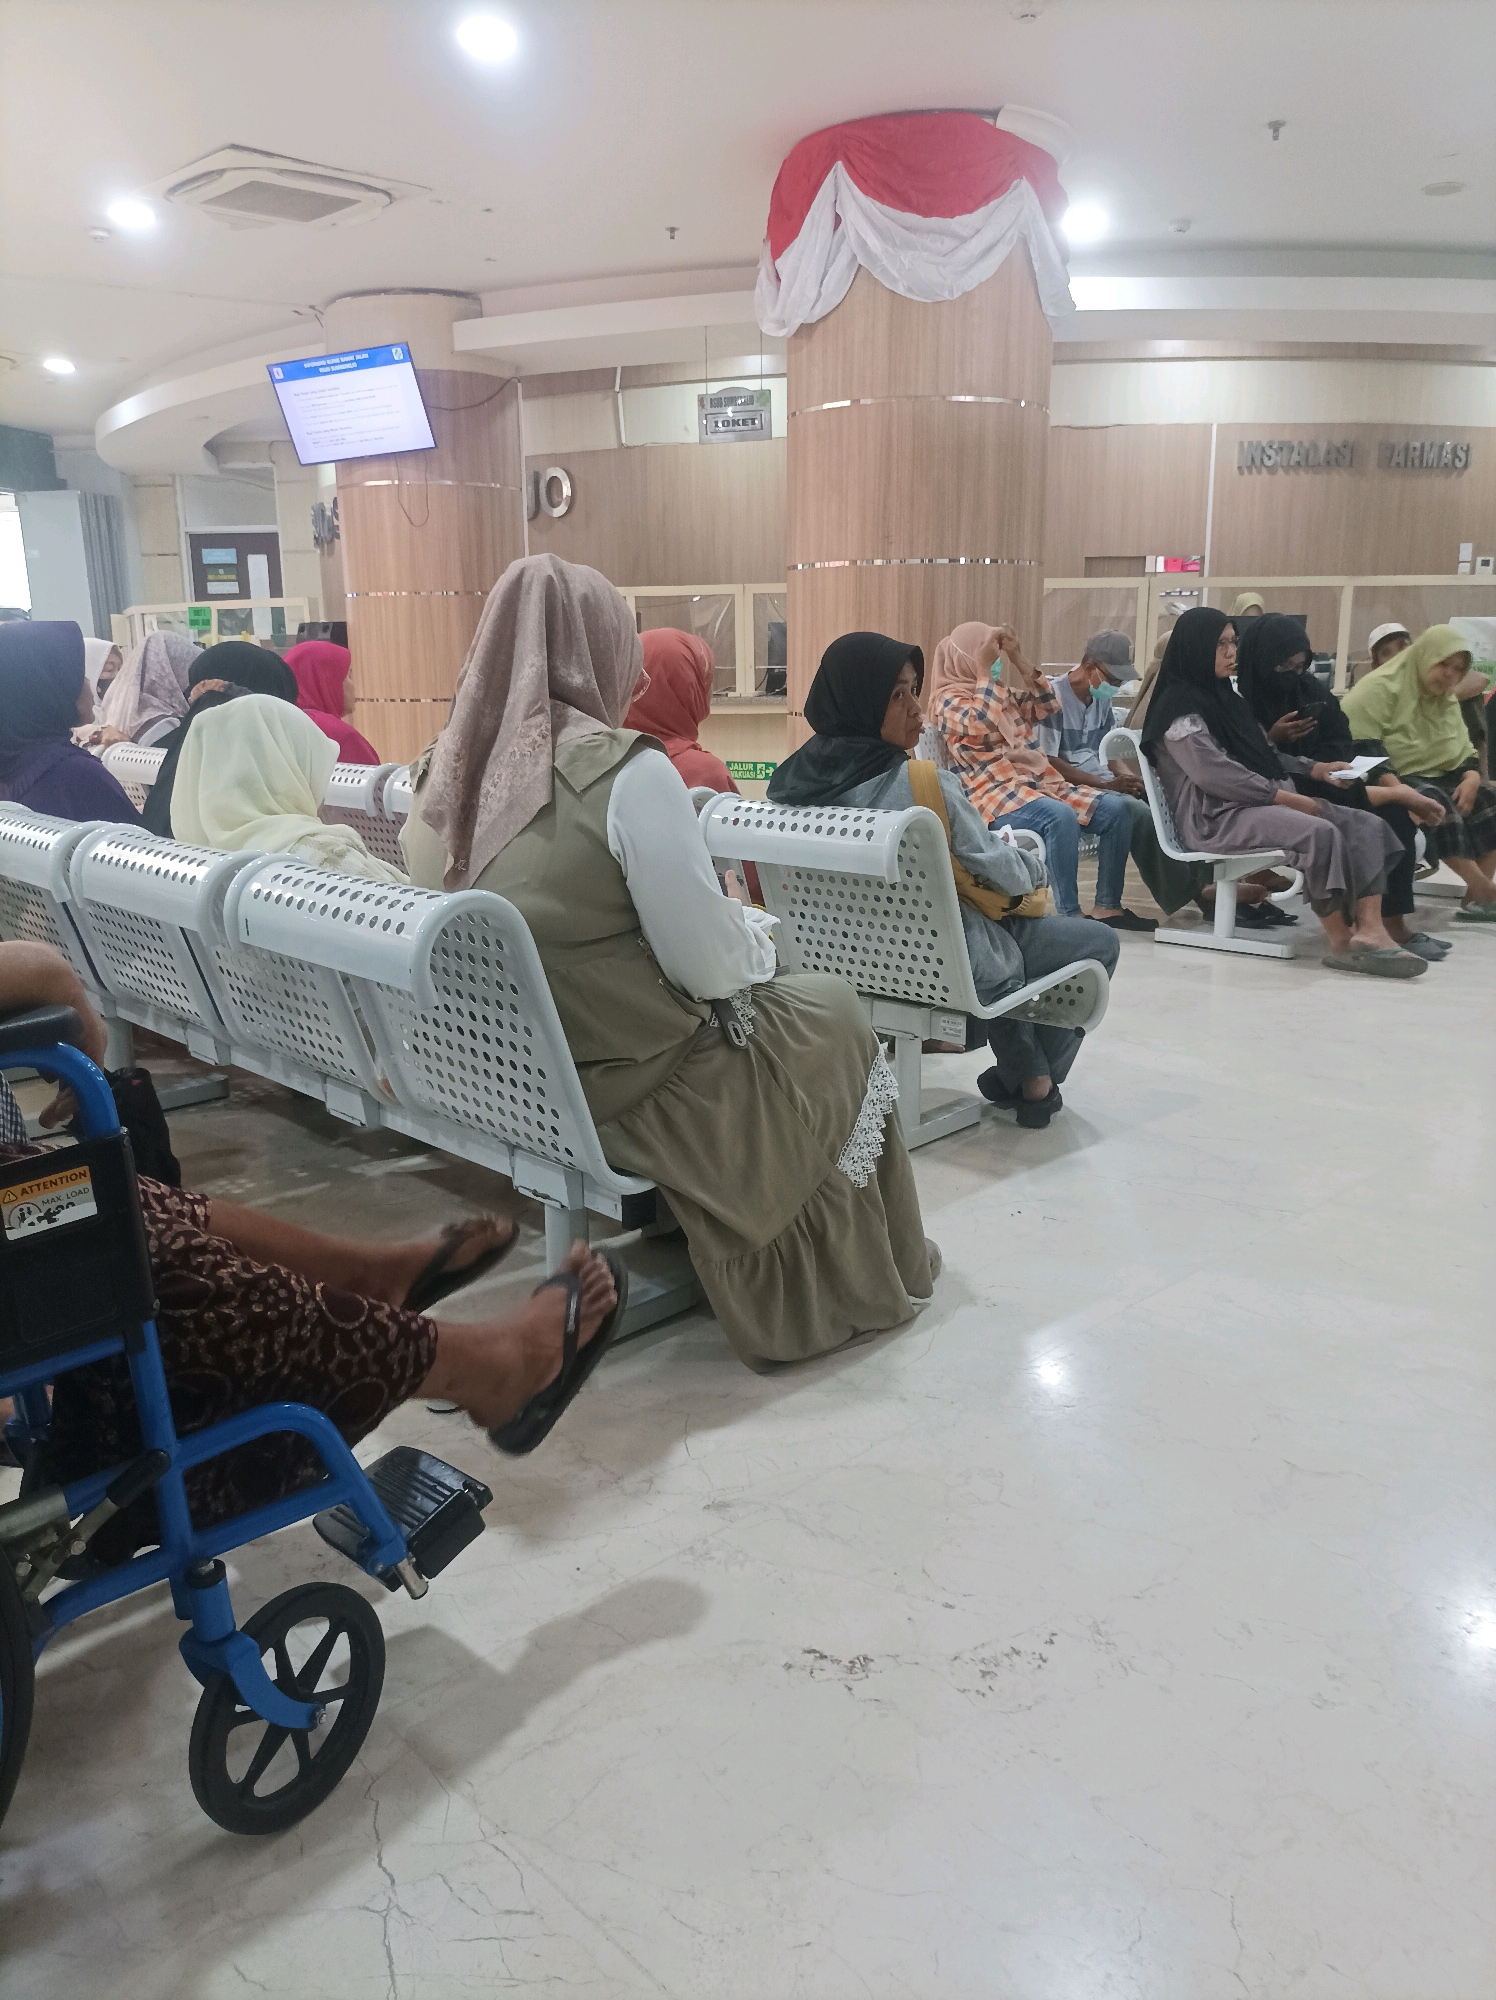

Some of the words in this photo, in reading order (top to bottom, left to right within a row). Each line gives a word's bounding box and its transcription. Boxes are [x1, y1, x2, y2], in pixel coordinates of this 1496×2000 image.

[713, 417, 759, 429] LOKET
[21, 1170, 87, 1196] ATTENTION
[66, 1187, 90, 1199] LOAD
